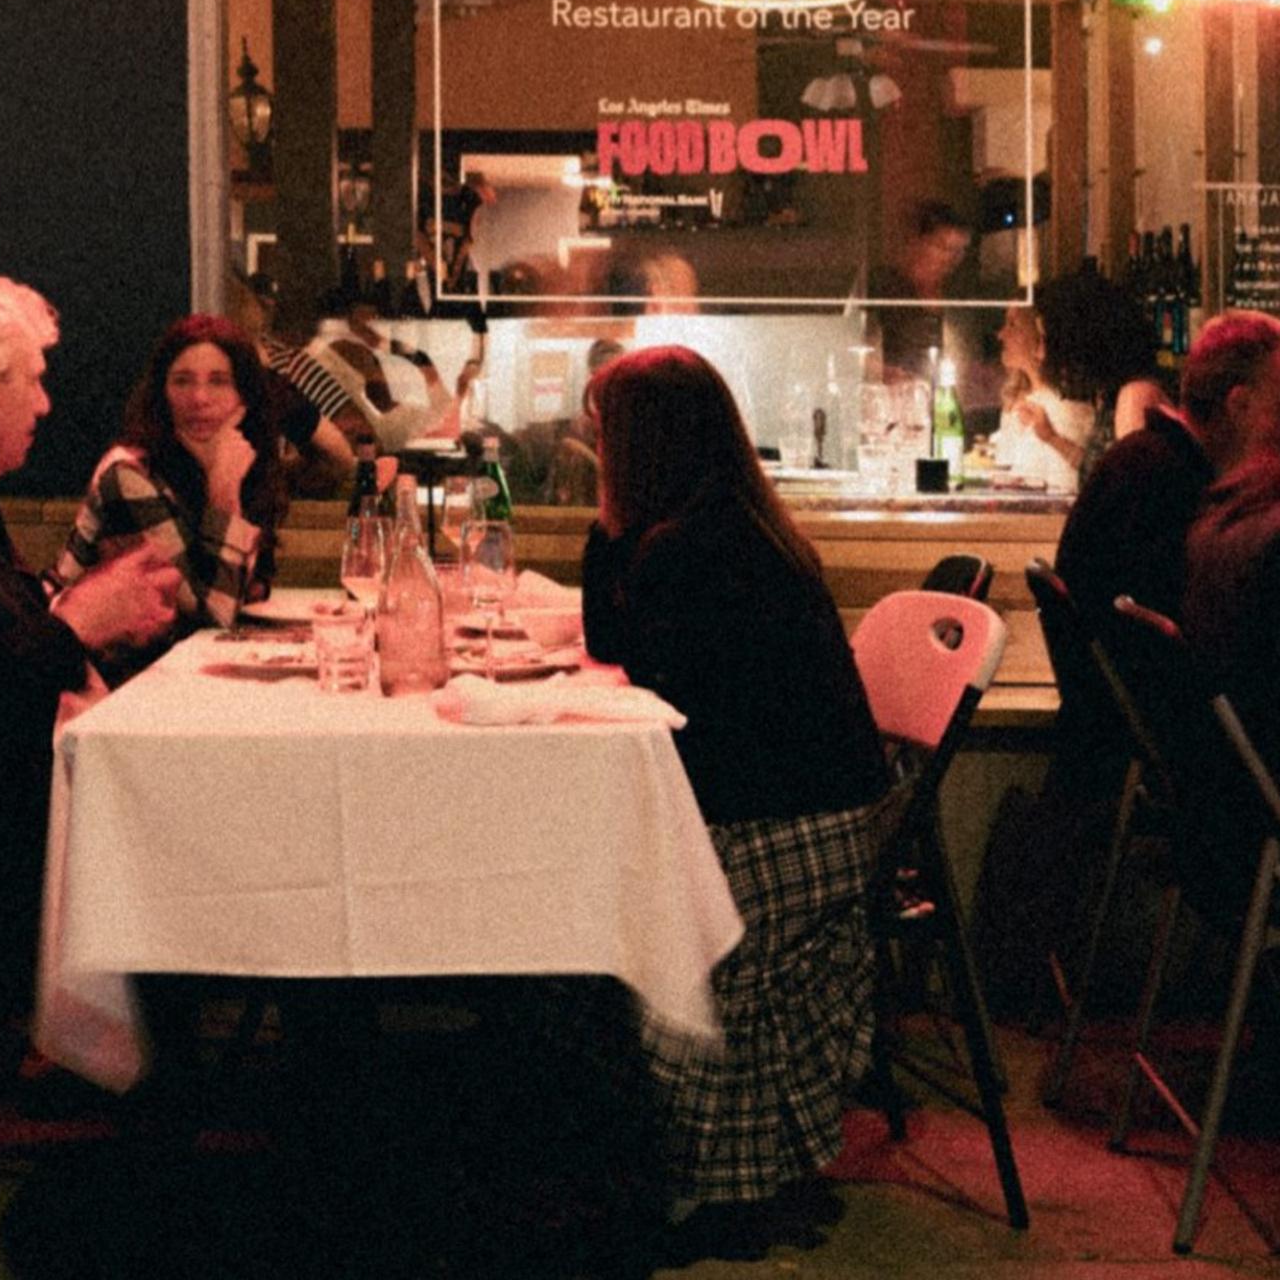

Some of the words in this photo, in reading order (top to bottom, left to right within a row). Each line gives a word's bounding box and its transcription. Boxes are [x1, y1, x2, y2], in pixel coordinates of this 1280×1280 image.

[736, 0, 770, 30] of
[781, 0, 834, 30] the
[844, 0, 915, 31] Year
[598, 98, 625, 114] Los
[627, 98, 682, 117] Angeles
[685, 98, 731, 115] Times
